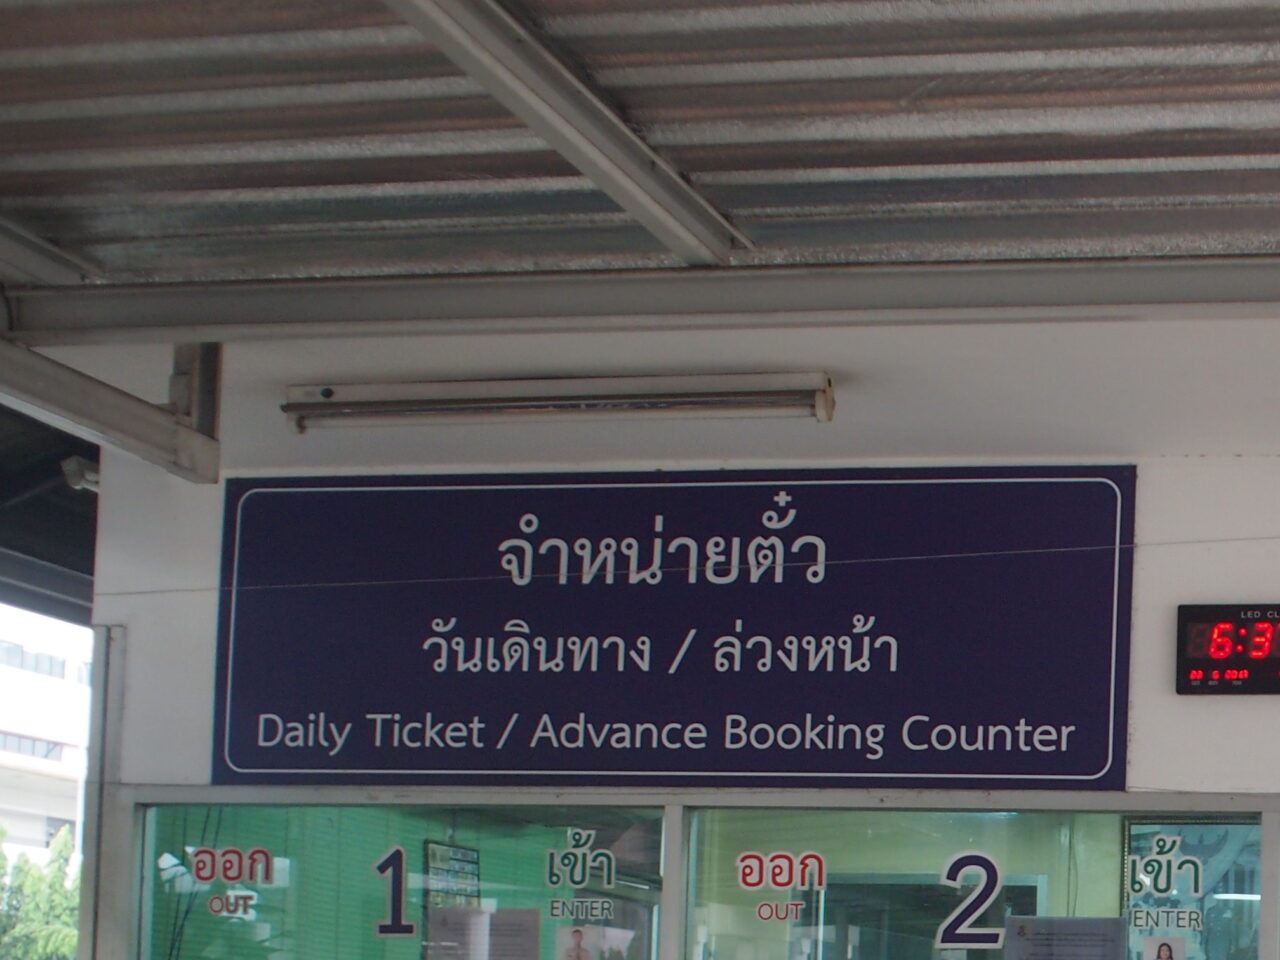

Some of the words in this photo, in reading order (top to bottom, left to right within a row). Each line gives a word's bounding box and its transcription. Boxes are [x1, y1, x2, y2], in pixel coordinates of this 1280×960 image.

[497, 490, 826, 586] จำหน่ายตั๋ว
[1240, 610, 1261, 619] LED
[422, 617, 651, 673] วันเดินทาง
[668, 628, 697, 674] /
[713, 614, 898, 673] ล่วงหน้า
[258, 712, 352, 756] Daily
[366, 712, 486, 749] Ticket
[496, 713, 519, 749] /
[530, 712, 708, 750] Advance
[725, 713, 885, 760] Booking
[902, 715, 1076, 753] Counter
[193, 848, 273, 883] ออก
[548, 830, 613, 886] เข้า
[738, 853, 826, 888] ออก
[1131, 838, 1199, 894] เข้า
[208, 895, 255, 915] OUT
[376, 847, 416, 935] 1
[550, 900, 614, 917] ENTER
[757, 902, 804, 921] OUT
[940, 855, 1001, 945] 2
[1133, 910, 1201, 928] ENTER
